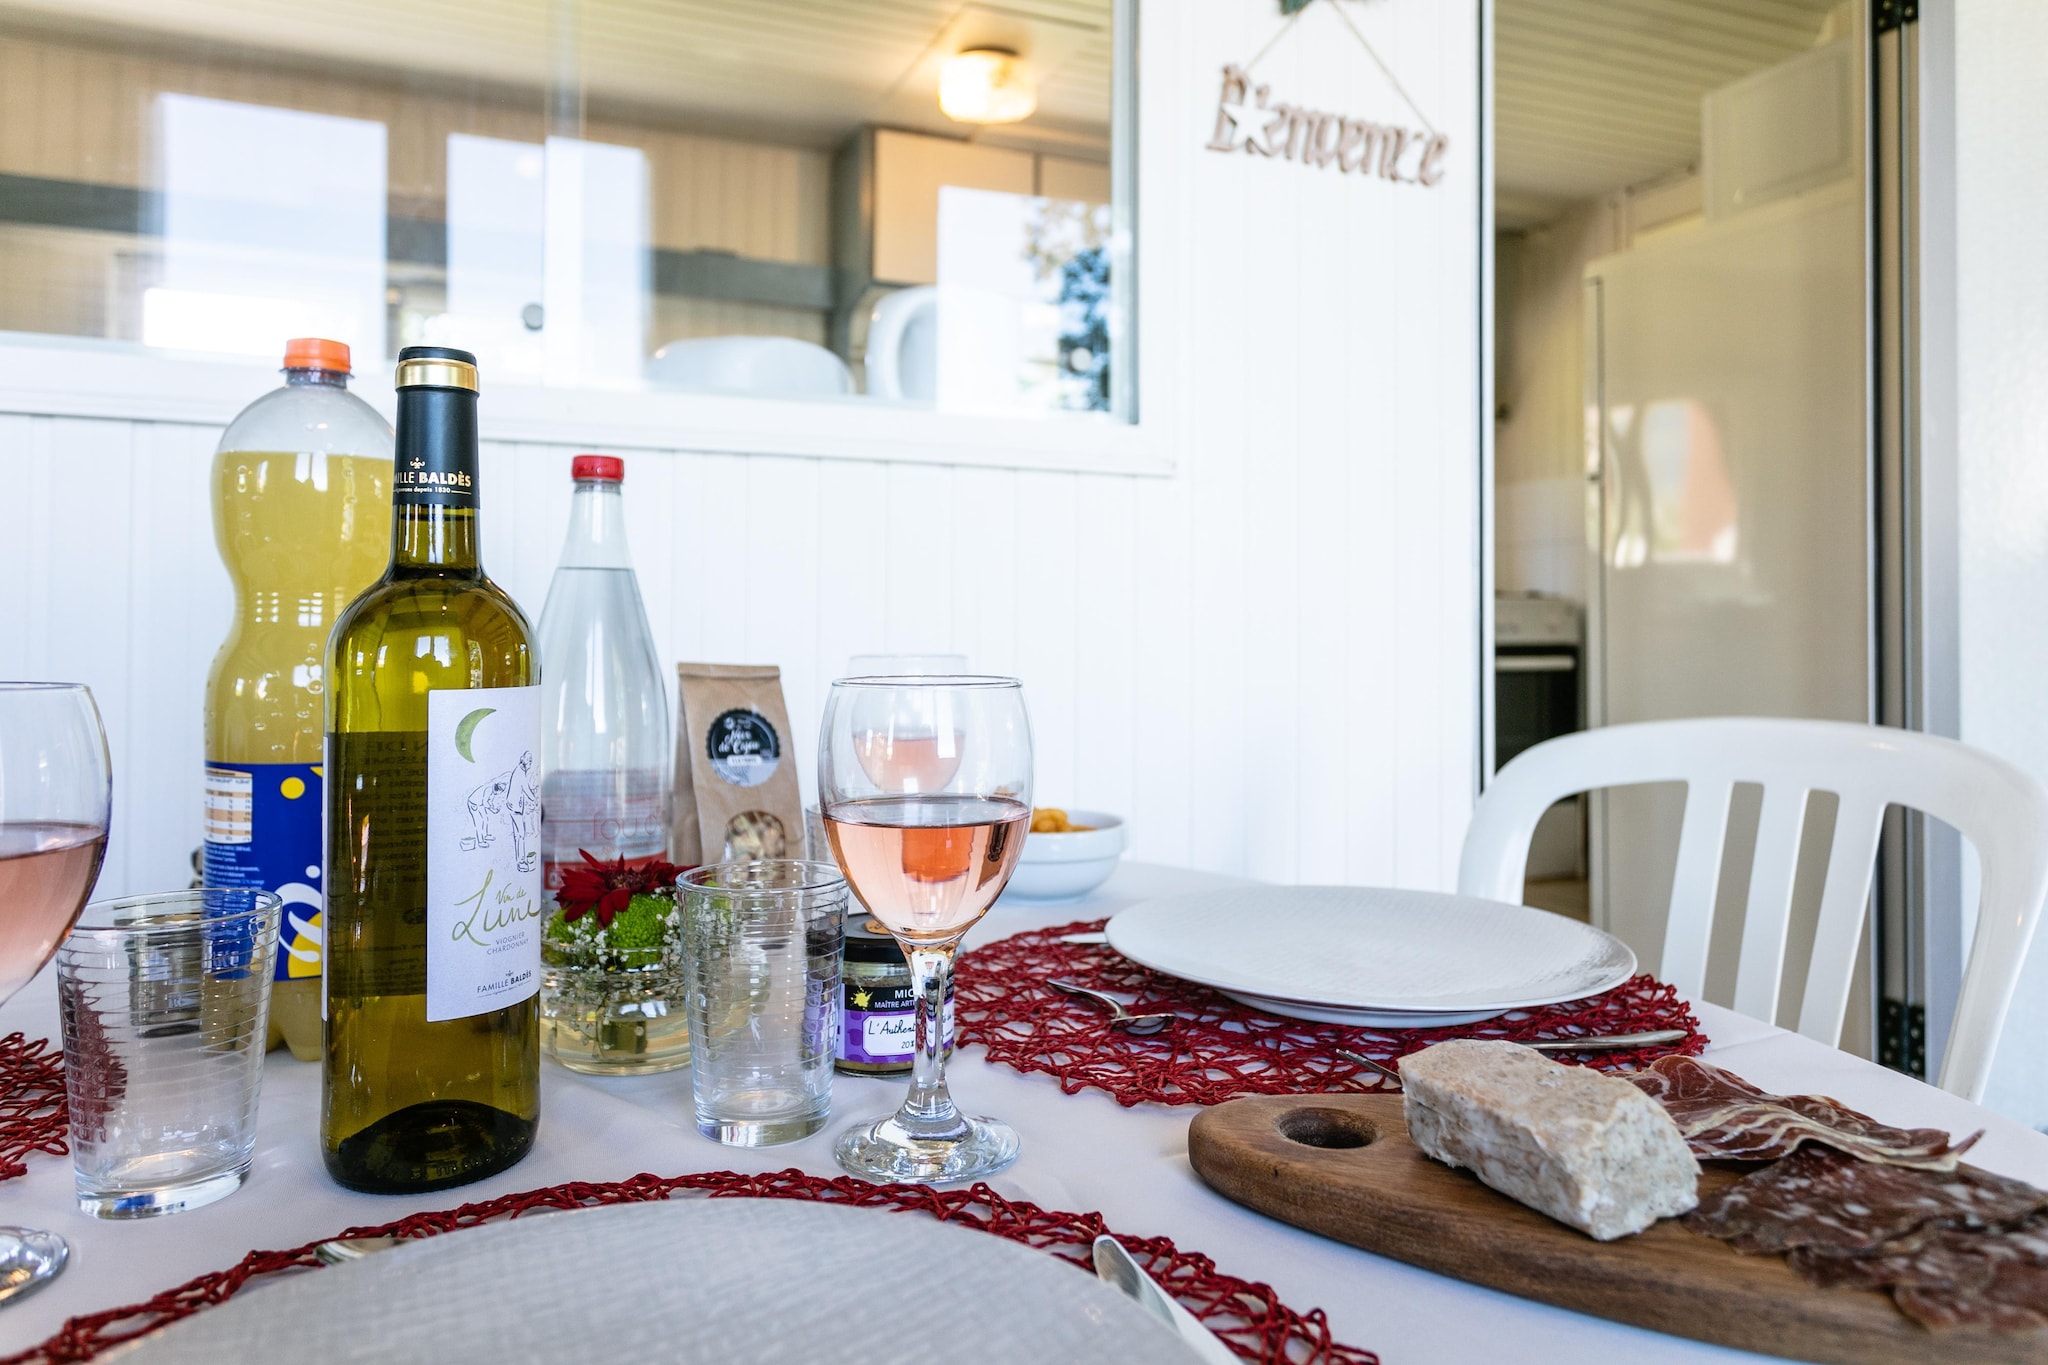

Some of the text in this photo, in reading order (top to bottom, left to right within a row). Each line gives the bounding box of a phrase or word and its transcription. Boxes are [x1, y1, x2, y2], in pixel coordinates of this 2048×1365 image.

[419, 470, 471, 487] BALDÈS
[487, 938, 529, 955] CHARDONNAY
[495, 931, 525, 945] VIOGNIER
[477, 978, 509, 994] FAMILLE
[510, 970, 532, 985] BALDÈS
[874, 999, 900, 1009] MAÎTRE
